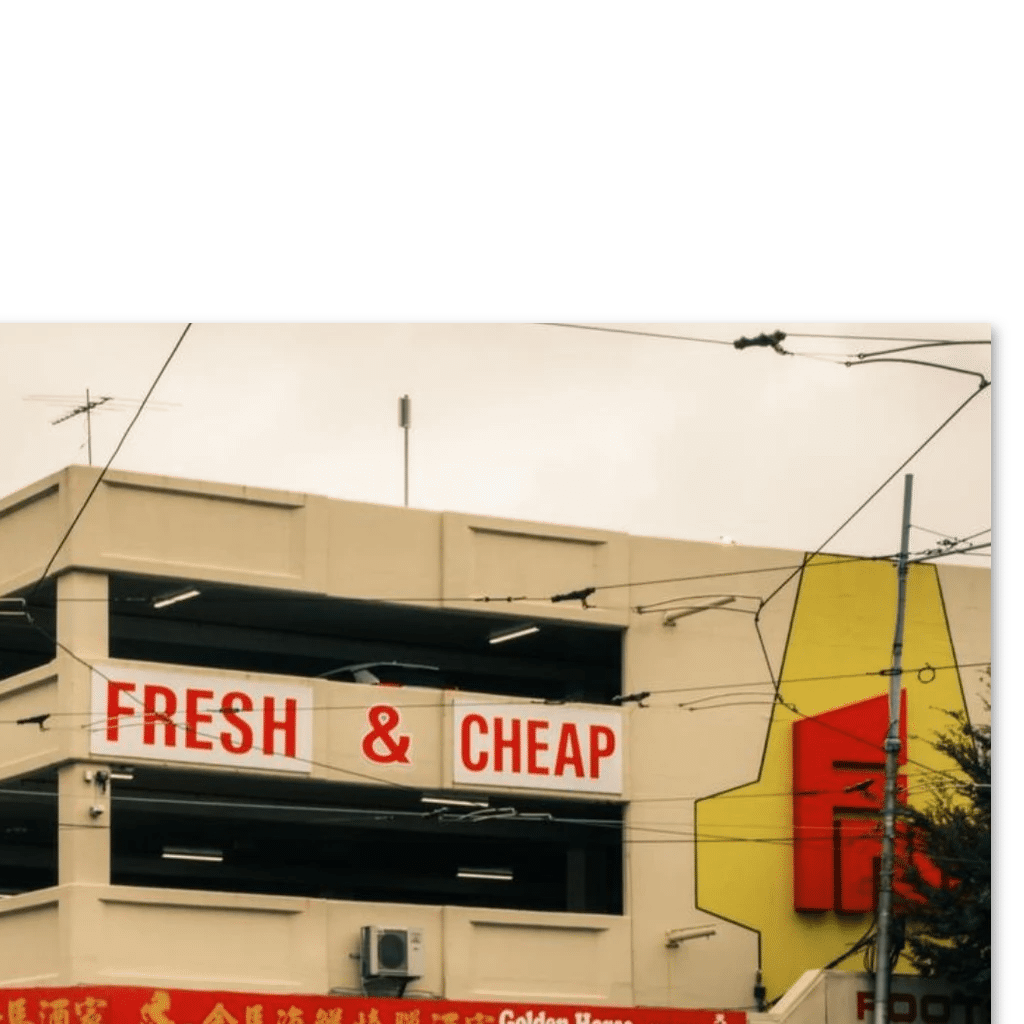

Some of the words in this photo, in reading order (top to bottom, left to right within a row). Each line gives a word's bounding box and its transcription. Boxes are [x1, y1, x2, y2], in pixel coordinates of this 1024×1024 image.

[105, 680, 298, 759] FRESH
[360, 704, 411, 765] &
[460, 712, 617, 781] CHEAP
